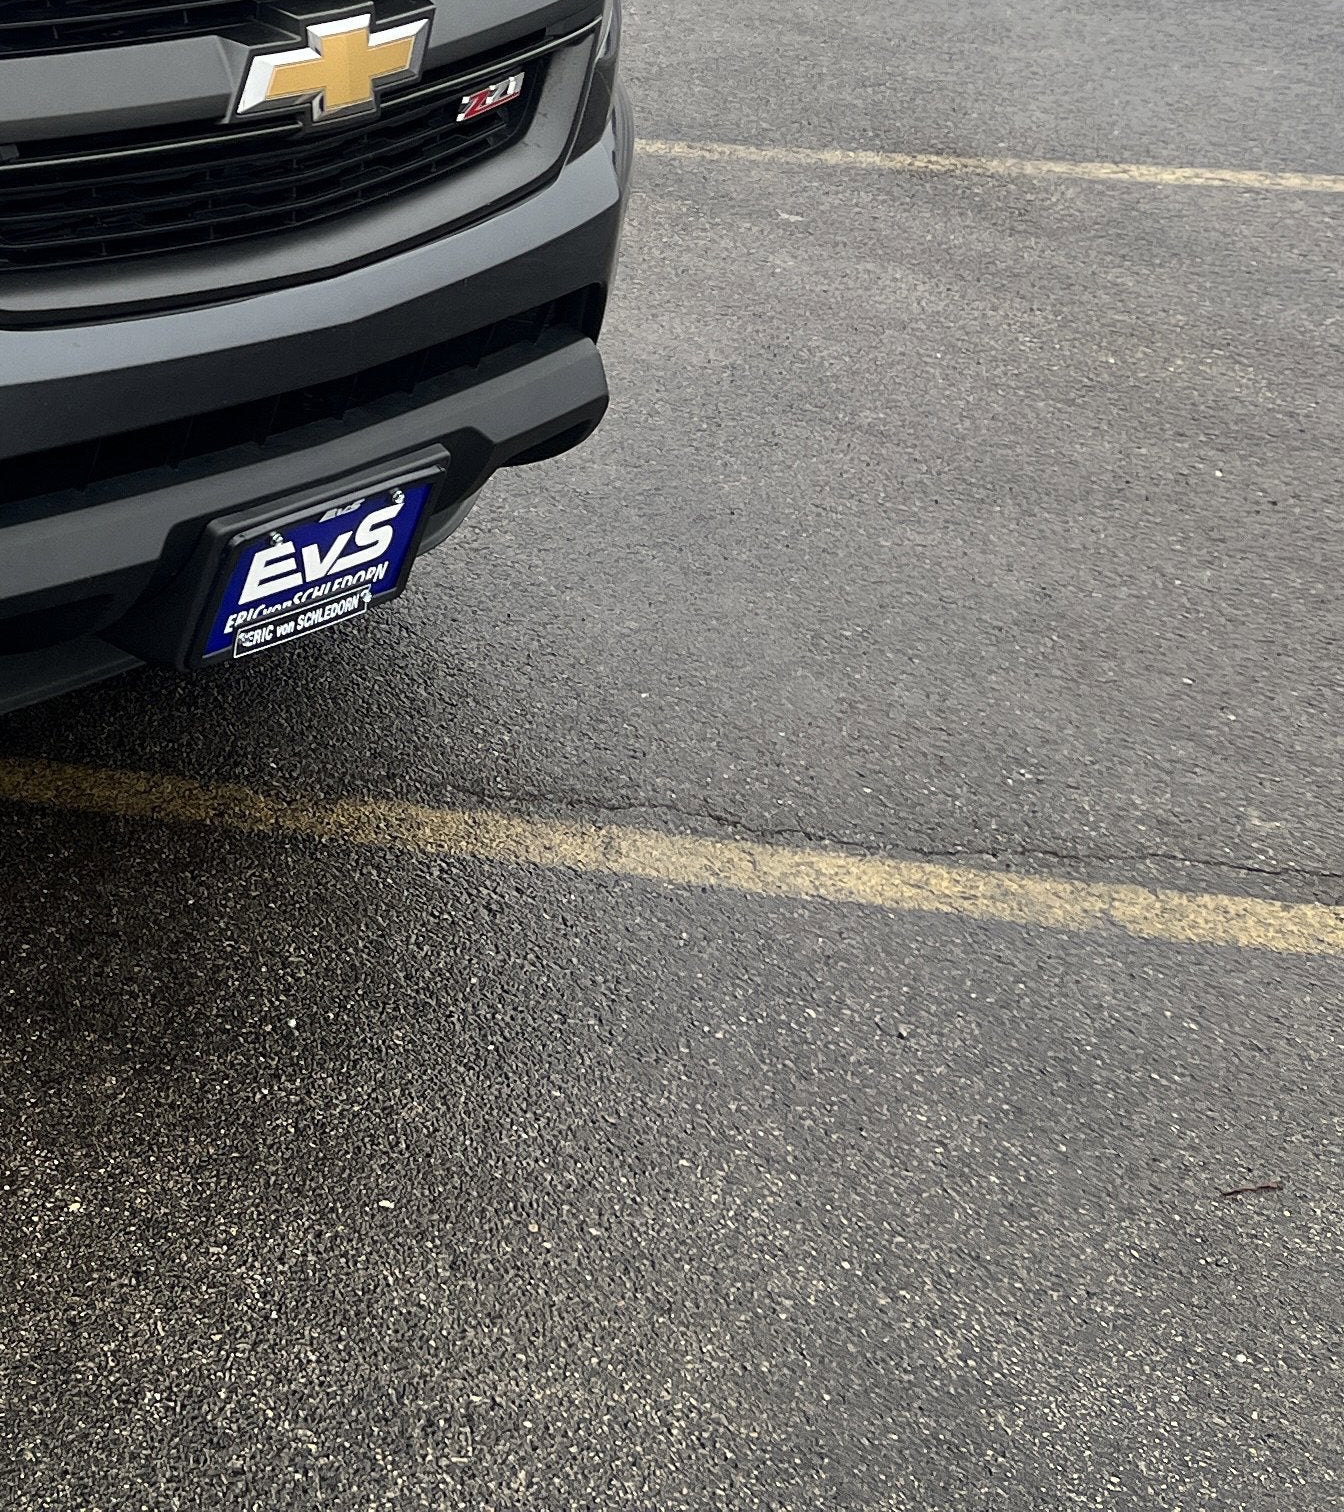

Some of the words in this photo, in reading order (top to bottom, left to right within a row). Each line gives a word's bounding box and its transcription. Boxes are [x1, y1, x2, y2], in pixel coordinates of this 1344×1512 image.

[456, 71, 525, 121] Z71
[276, 621, 295, 637] von
[296, 594, 359, 630] SCHLEDORN
